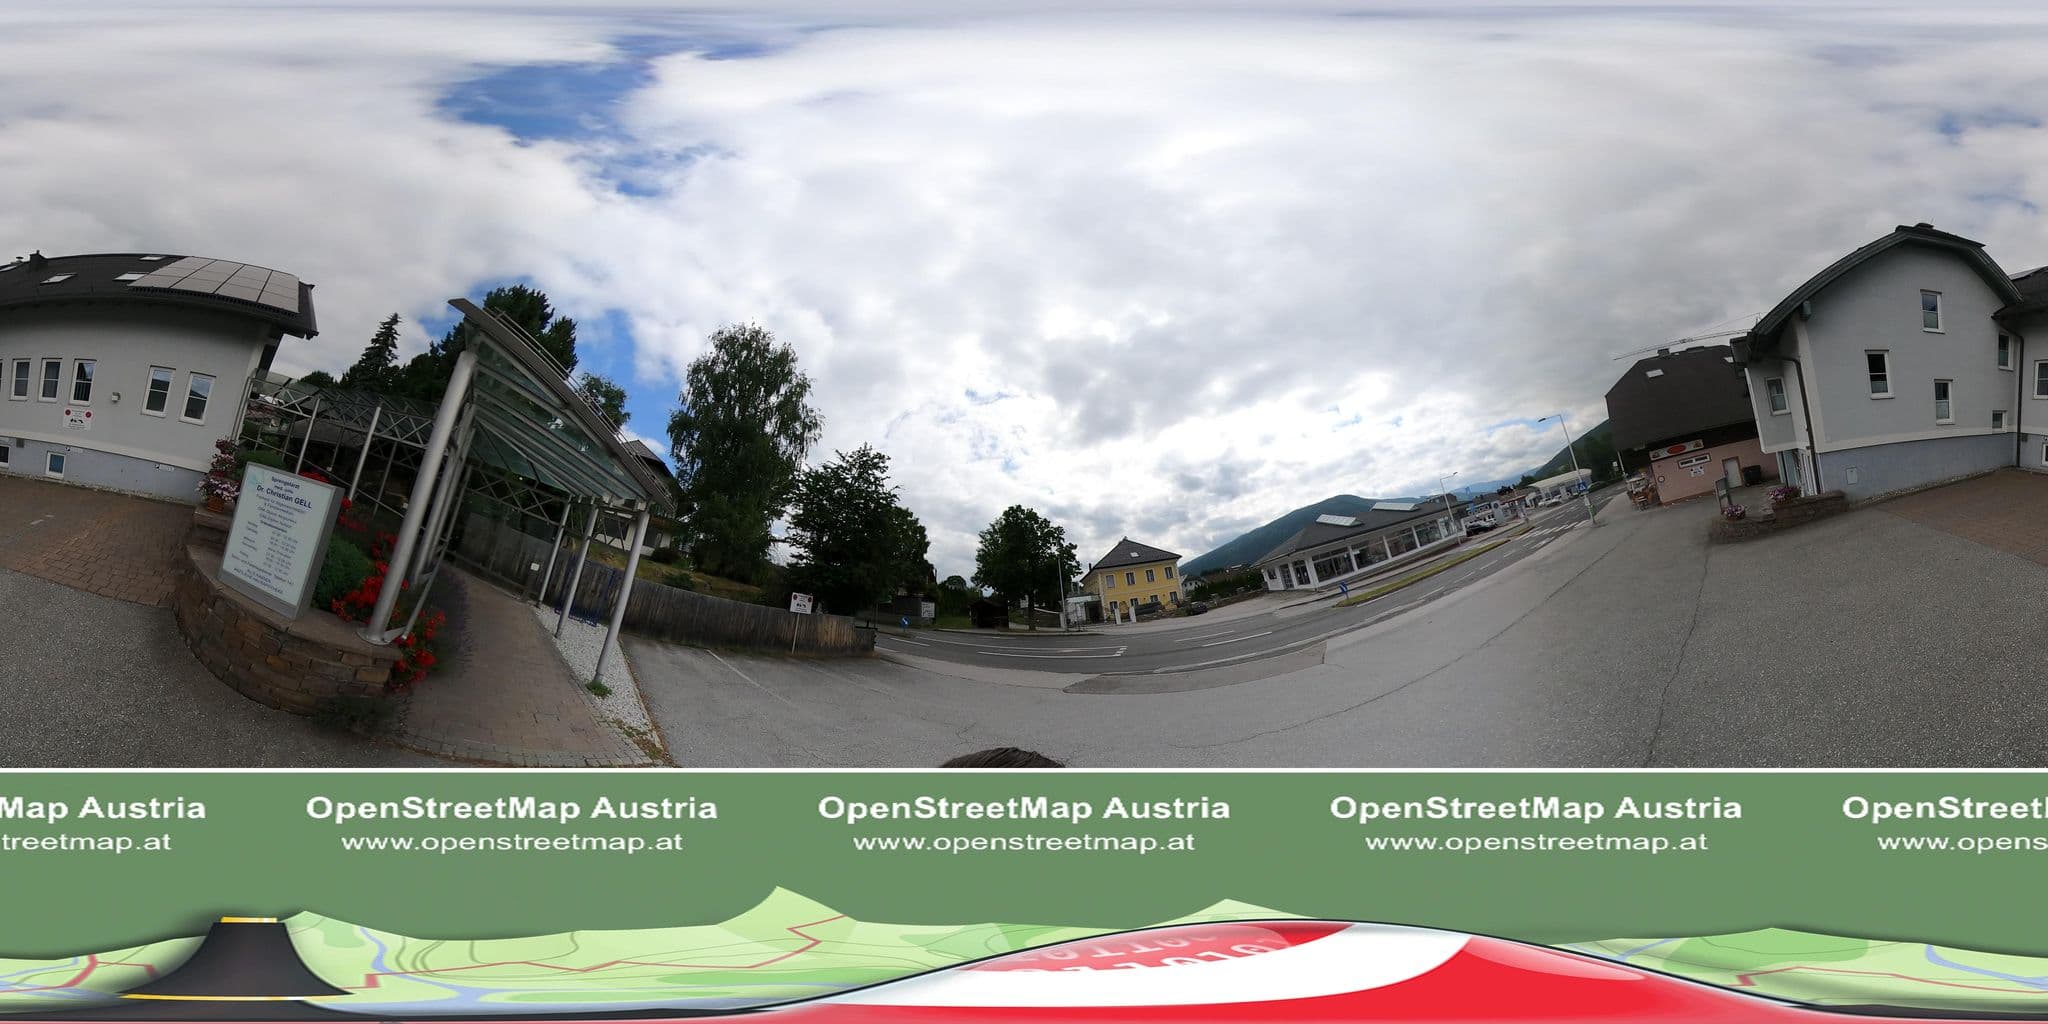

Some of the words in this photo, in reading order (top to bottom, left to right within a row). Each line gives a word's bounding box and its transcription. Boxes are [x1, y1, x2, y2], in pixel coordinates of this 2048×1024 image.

[256, 484, 264, 493] Dr.
[266, 487, 293, 503] Christian
[294, 497, 312, 509] GELL
